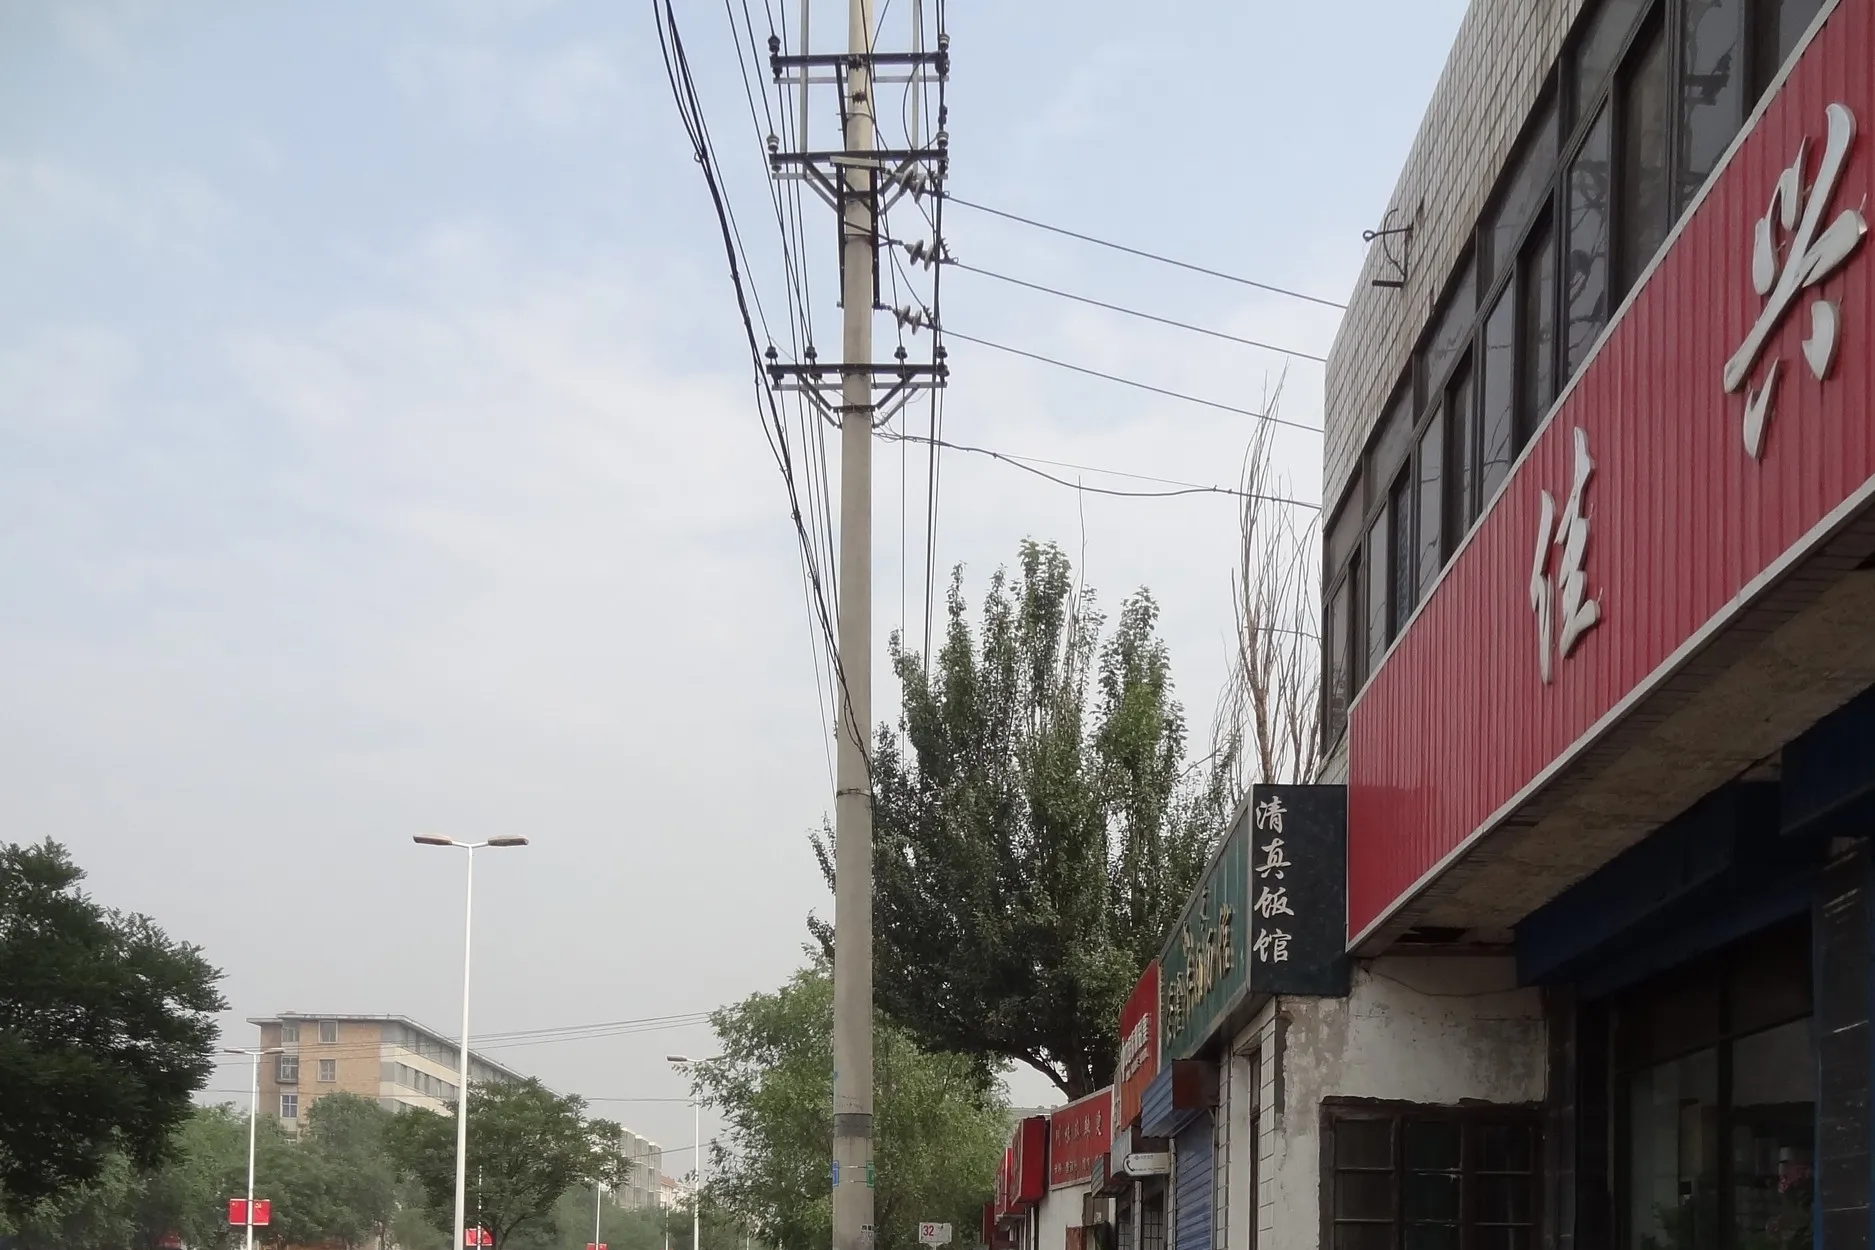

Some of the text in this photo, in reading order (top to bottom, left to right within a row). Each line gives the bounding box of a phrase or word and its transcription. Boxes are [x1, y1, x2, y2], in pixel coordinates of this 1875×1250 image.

[1253, 795, 1295, 963] 清真饭馆
[923, 1225, 934, 1237] 32
